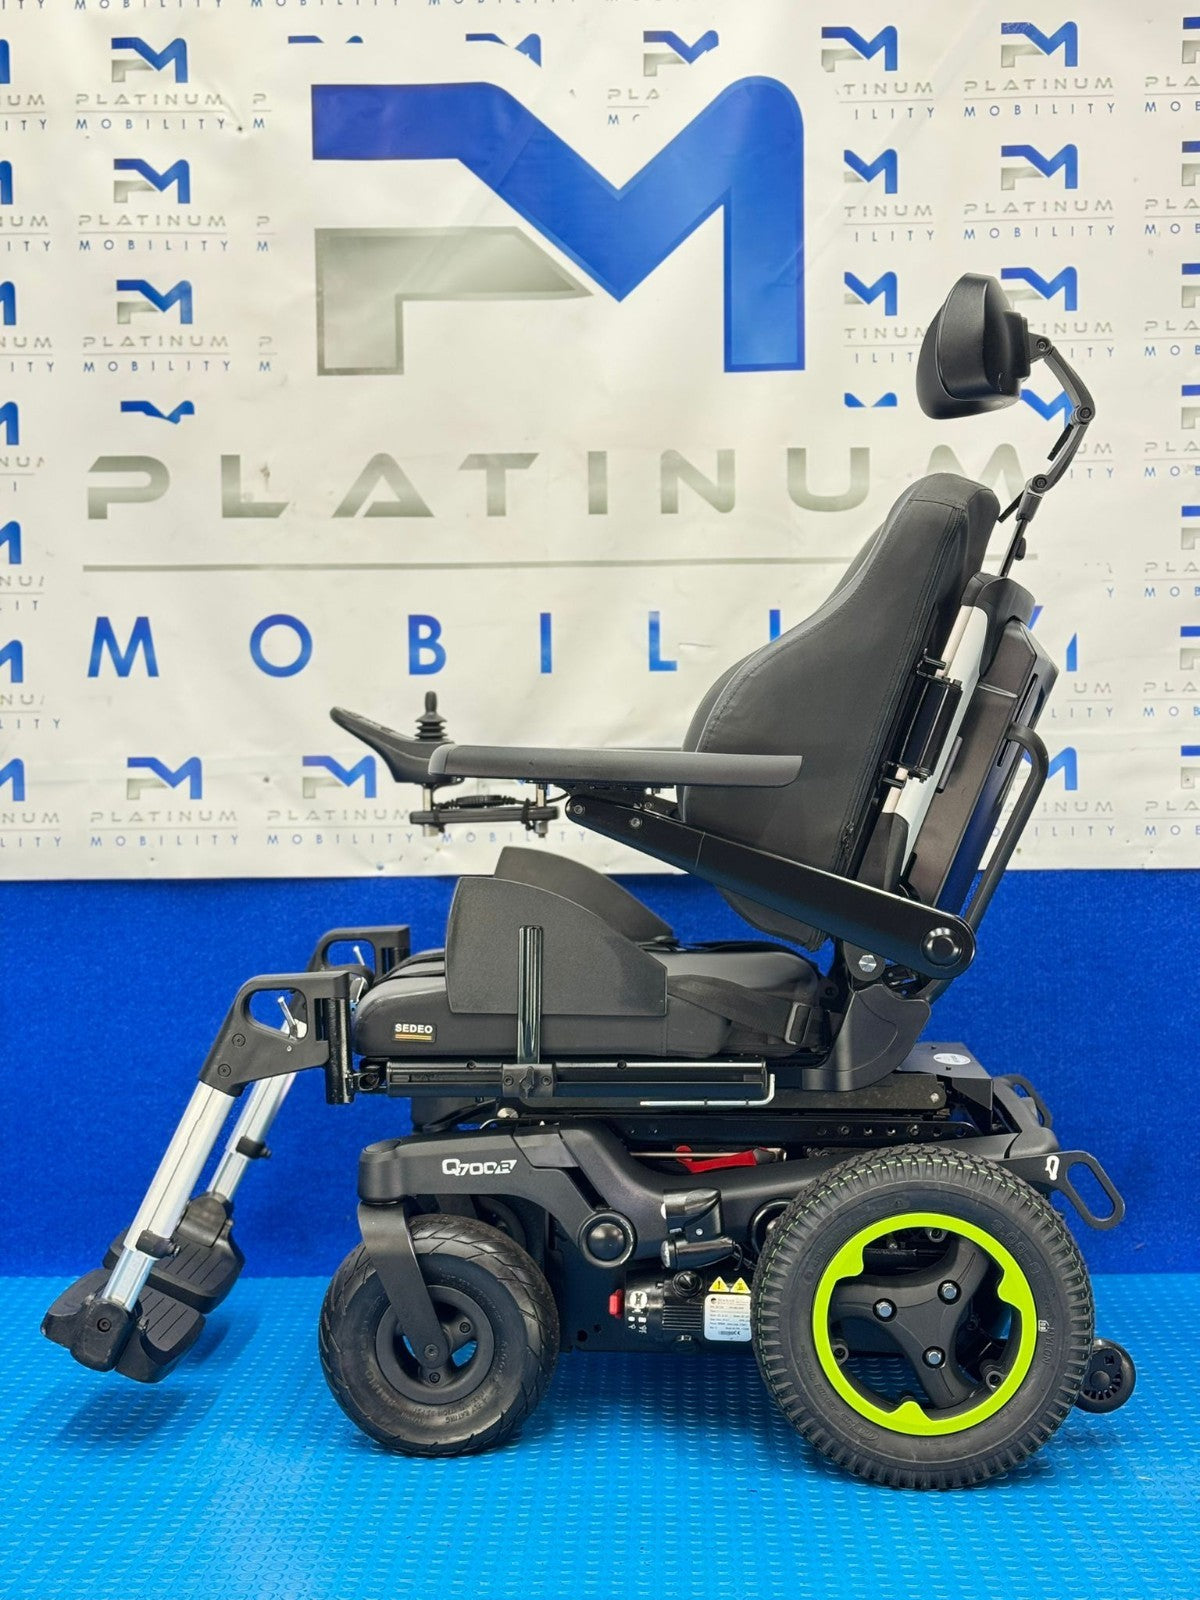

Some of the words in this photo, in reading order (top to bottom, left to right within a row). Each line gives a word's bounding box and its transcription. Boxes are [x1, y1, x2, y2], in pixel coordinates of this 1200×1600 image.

[963, 77, 1114, 93] PLATINUM
[75, 93, 224, 106] PLATINUM
[963, 102, 1115, 118] MOBILITY
[76, 119, 224, 129] MOBILITY
[963, 200, 1114, 215] PLATINUM
[78, 214, 226, 227] PLATINUM
[963, 225, 1115, 241] MOBILITY
[79, 239, 228, 251] MOBILITY
[83, 335, 228, 348] PLATINUM
[83, 361, 230, 372] MOBILITY
[87, 443, 1027, 519] PLATINUM
[90, 810, 237, 823] PLATINUM
[90, 834, 238, 847] MOBILITY
[267, 833, 413, 845] MOBILITY
[393, 1020, 434, 1036] SEDEO
